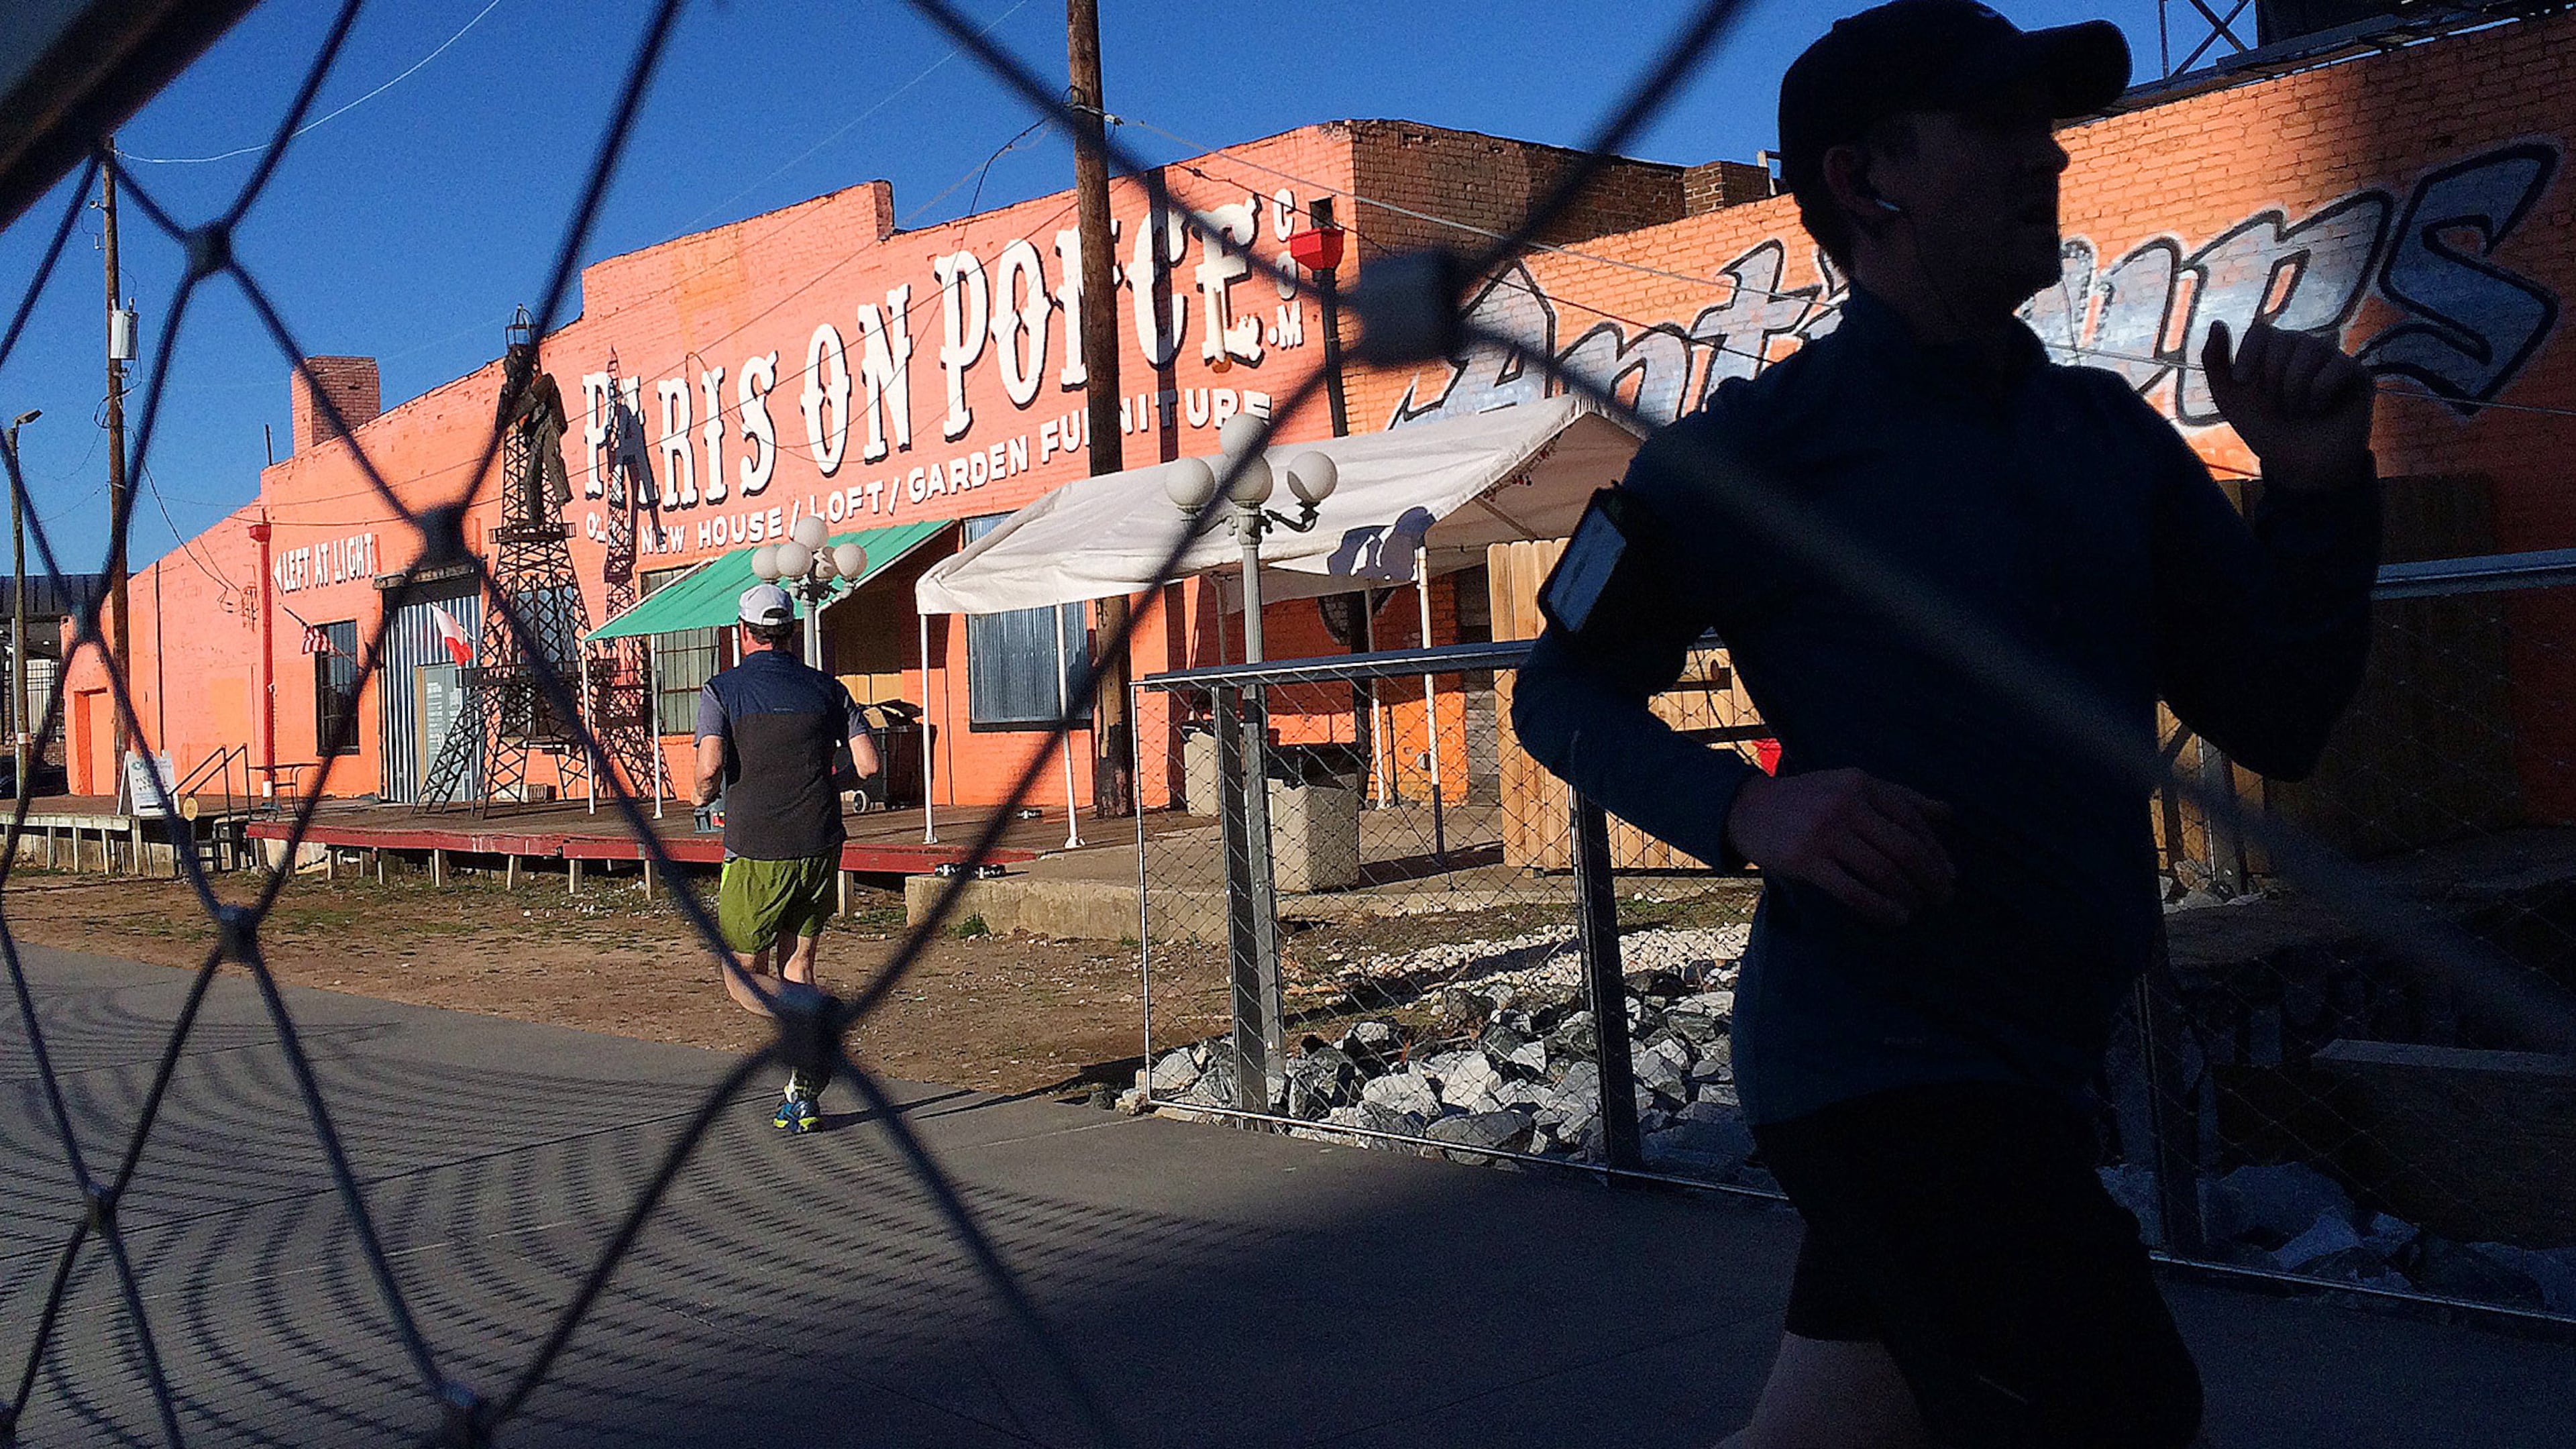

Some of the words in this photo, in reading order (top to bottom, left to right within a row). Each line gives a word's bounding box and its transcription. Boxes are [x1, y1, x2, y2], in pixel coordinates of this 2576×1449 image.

[582, 351, 778, 510] PARIS
[800, 283, 914, 478] ON
[697, 506, 784, 549] HOUSE
[907, 434, 1030, 504] GARDEN
[1040, 386, 1272, 464] FUNITURE
[282, 547, 310, 593] LEFT
[314, 542, 329, 589] AT
[333, 532, 373, 584] LIGHT
